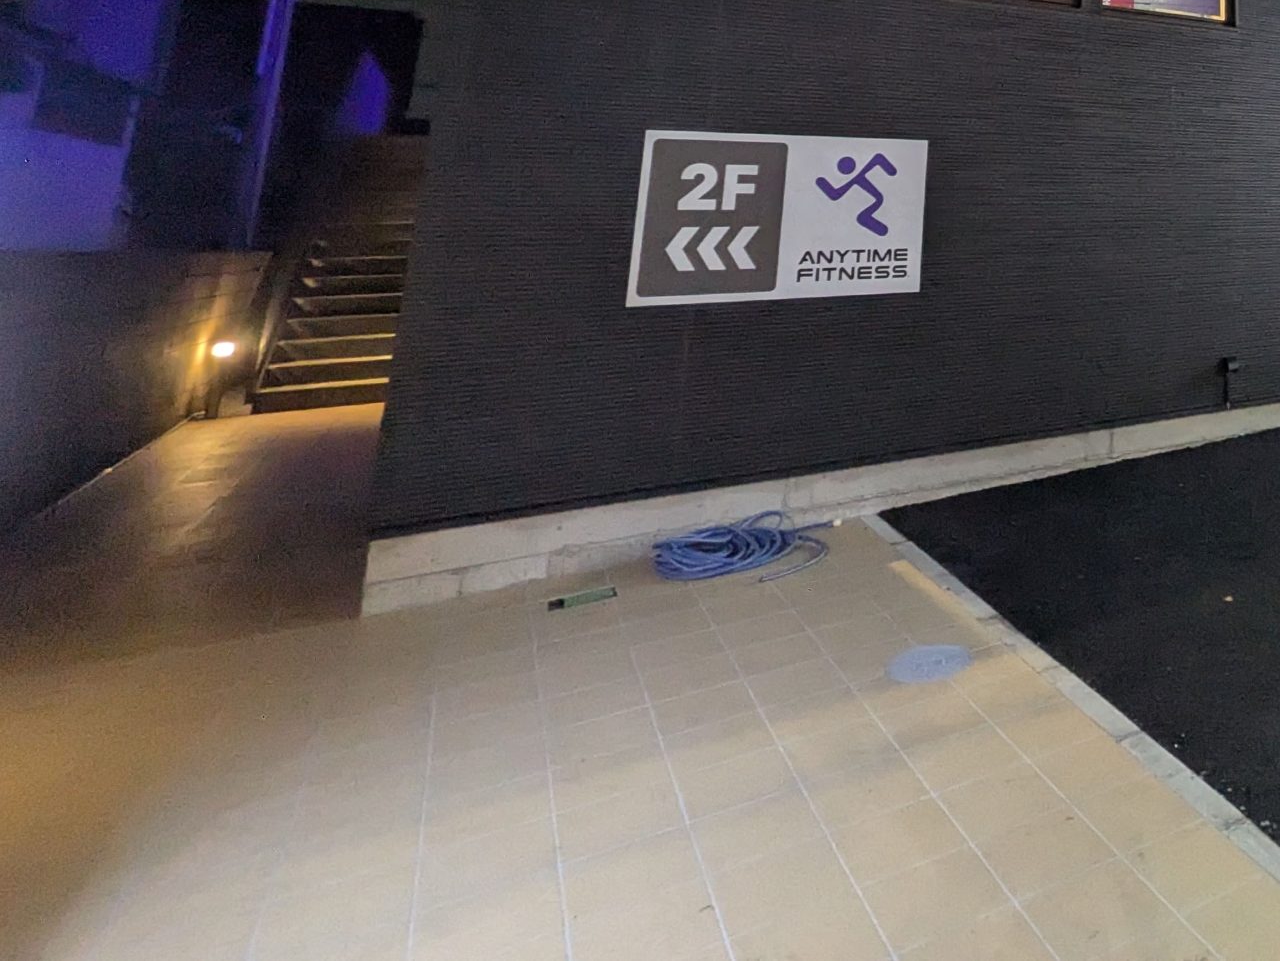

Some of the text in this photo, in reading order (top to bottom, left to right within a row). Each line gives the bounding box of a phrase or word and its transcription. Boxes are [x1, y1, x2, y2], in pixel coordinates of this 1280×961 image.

[677, 163, 759, 211] 2F
[798, 248, 909, 265] ANYTIME
[796, 264, 909, 283] FITNESS
